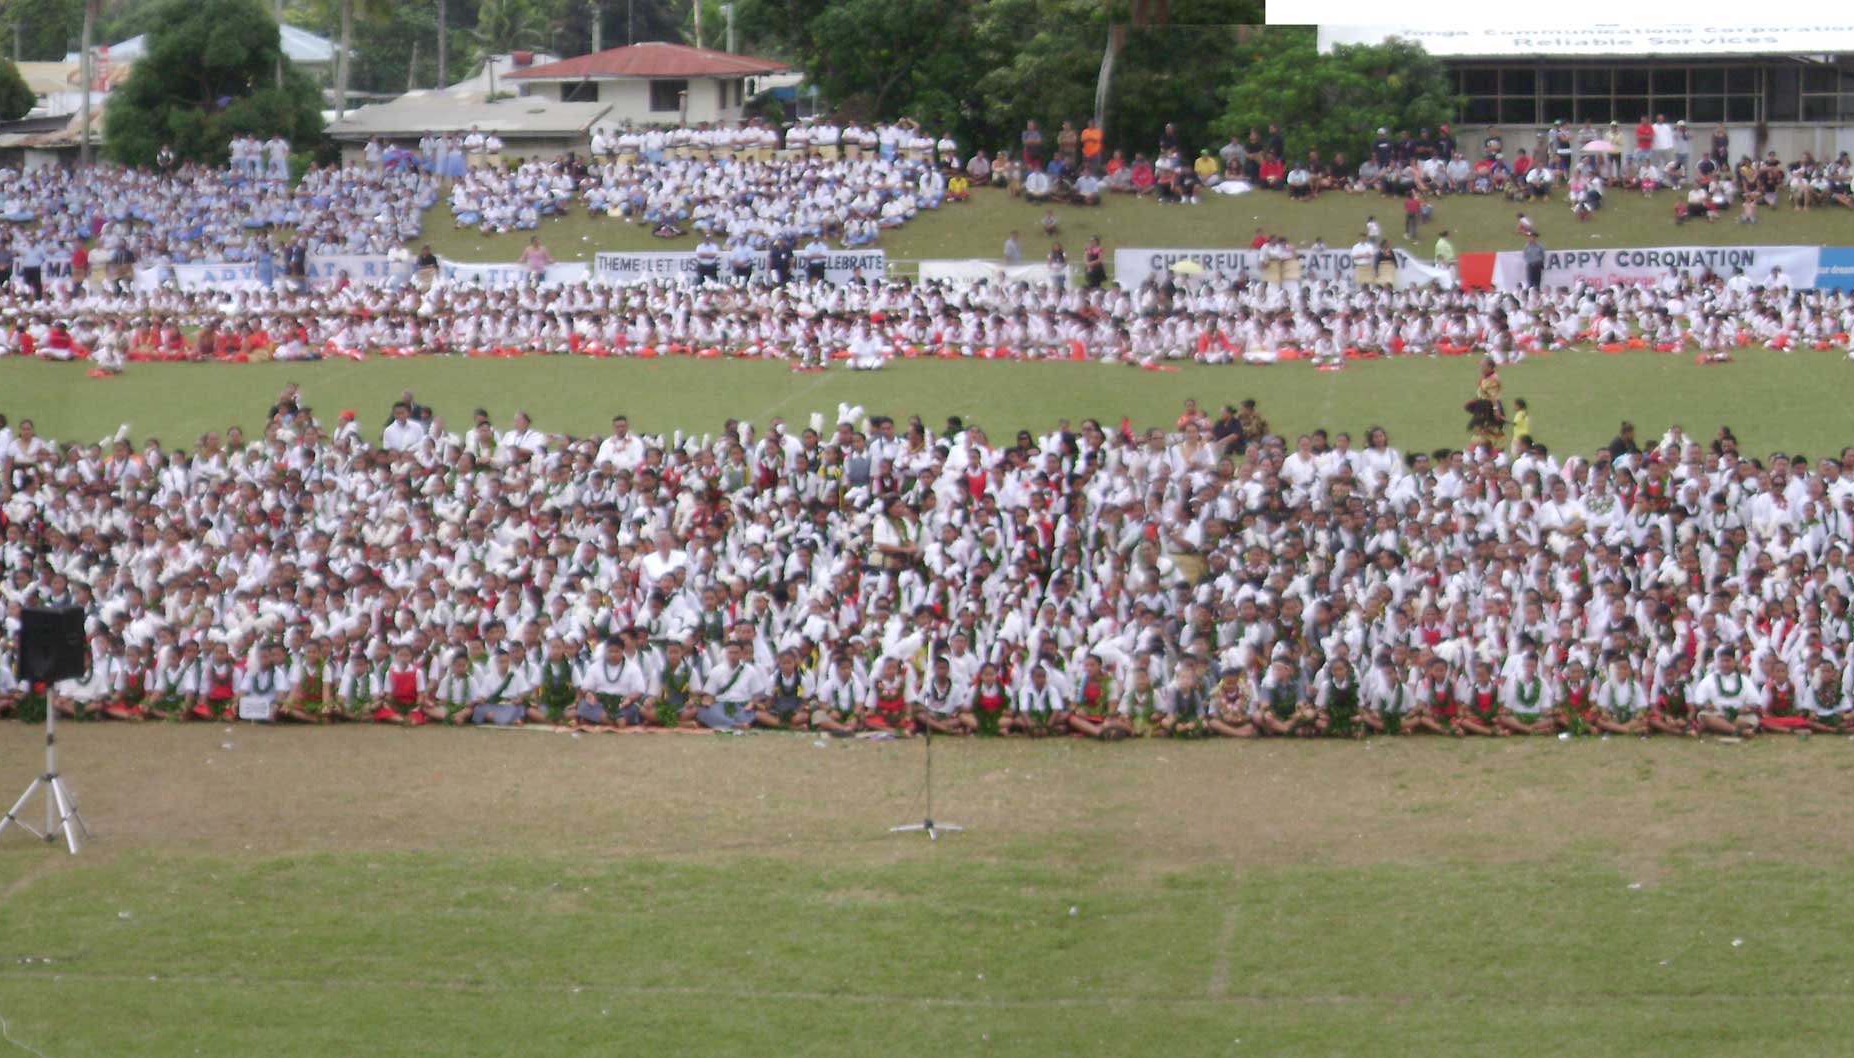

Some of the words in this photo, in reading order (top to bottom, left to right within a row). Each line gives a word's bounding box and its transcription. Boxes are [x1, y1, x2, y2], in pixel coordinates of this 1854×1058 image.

[1483, 26, 1691, 37] Communications
[1512, 37, 1634, 47] Reliable
[1645, 35, 1780, 46] Services
[1546, 252, 1605, 269] APPY
[1614, 249, 1755, 268] CORONATION
